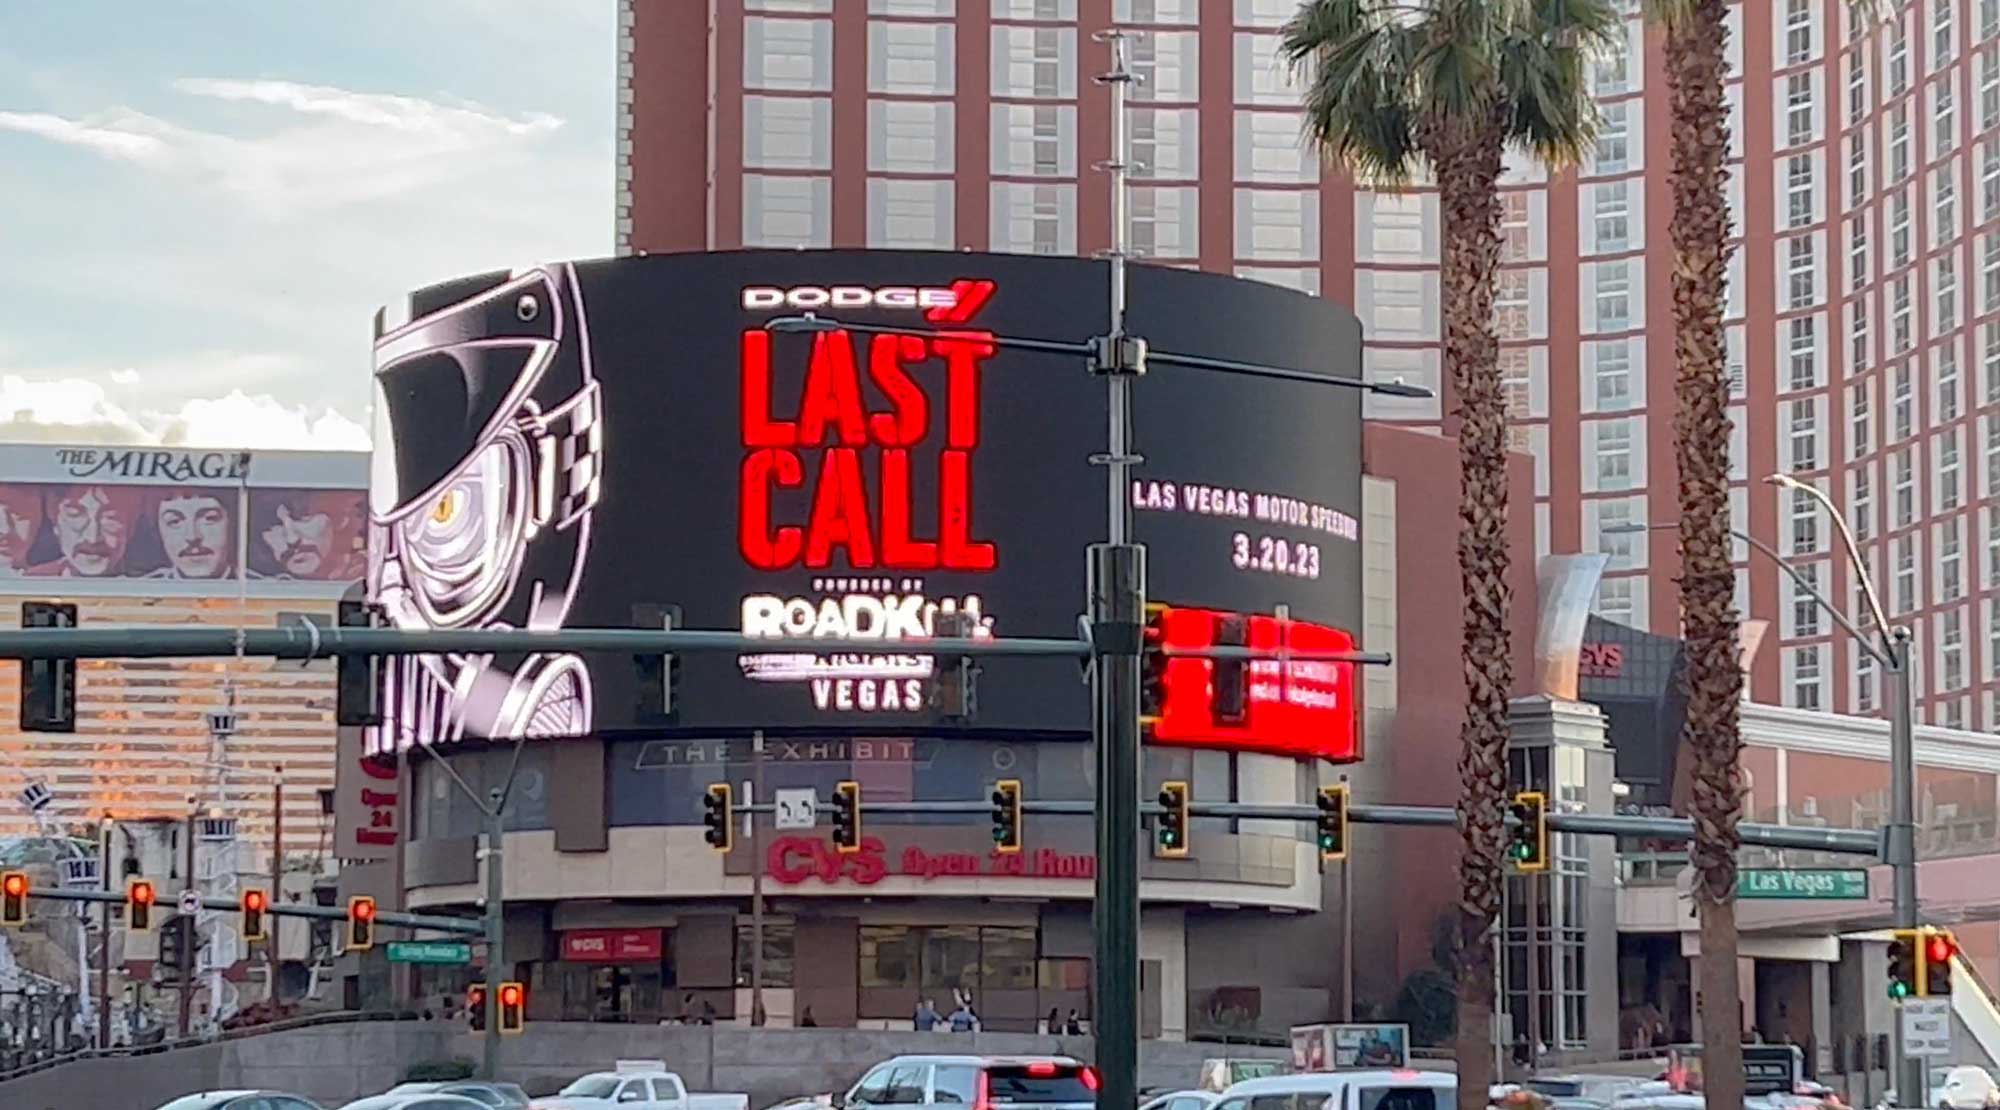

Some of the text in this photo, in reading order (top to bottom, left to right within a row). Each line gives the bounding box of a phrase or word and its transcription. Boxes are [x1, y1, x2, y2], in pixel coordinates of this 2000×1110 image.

[744, 287, 957, 308] DODGE
[744, 329, 993, 447] LAST
[56, 450, 97, 464] THE
[742, 448, 994, 568] CALL
[1132, 481, 1176, 510] LAS
[1183, 485, 1249, 518] VEGAS
[1255, 493, 1308, 527] MOTOR
[1232, 532, 1320, 578] 3.20.23
[812, 678, 922, 711] VEGAS
[663, 741, 915, 761] THE EXHIBIT
[371, 811, 393, 827] 24
[767, 837, 888, 884] CVS
[1034, 848, 1095, 878] Hou
[1749, 871, 1779, 890] Las
[1782, 870, 1834, 895] Vegas
